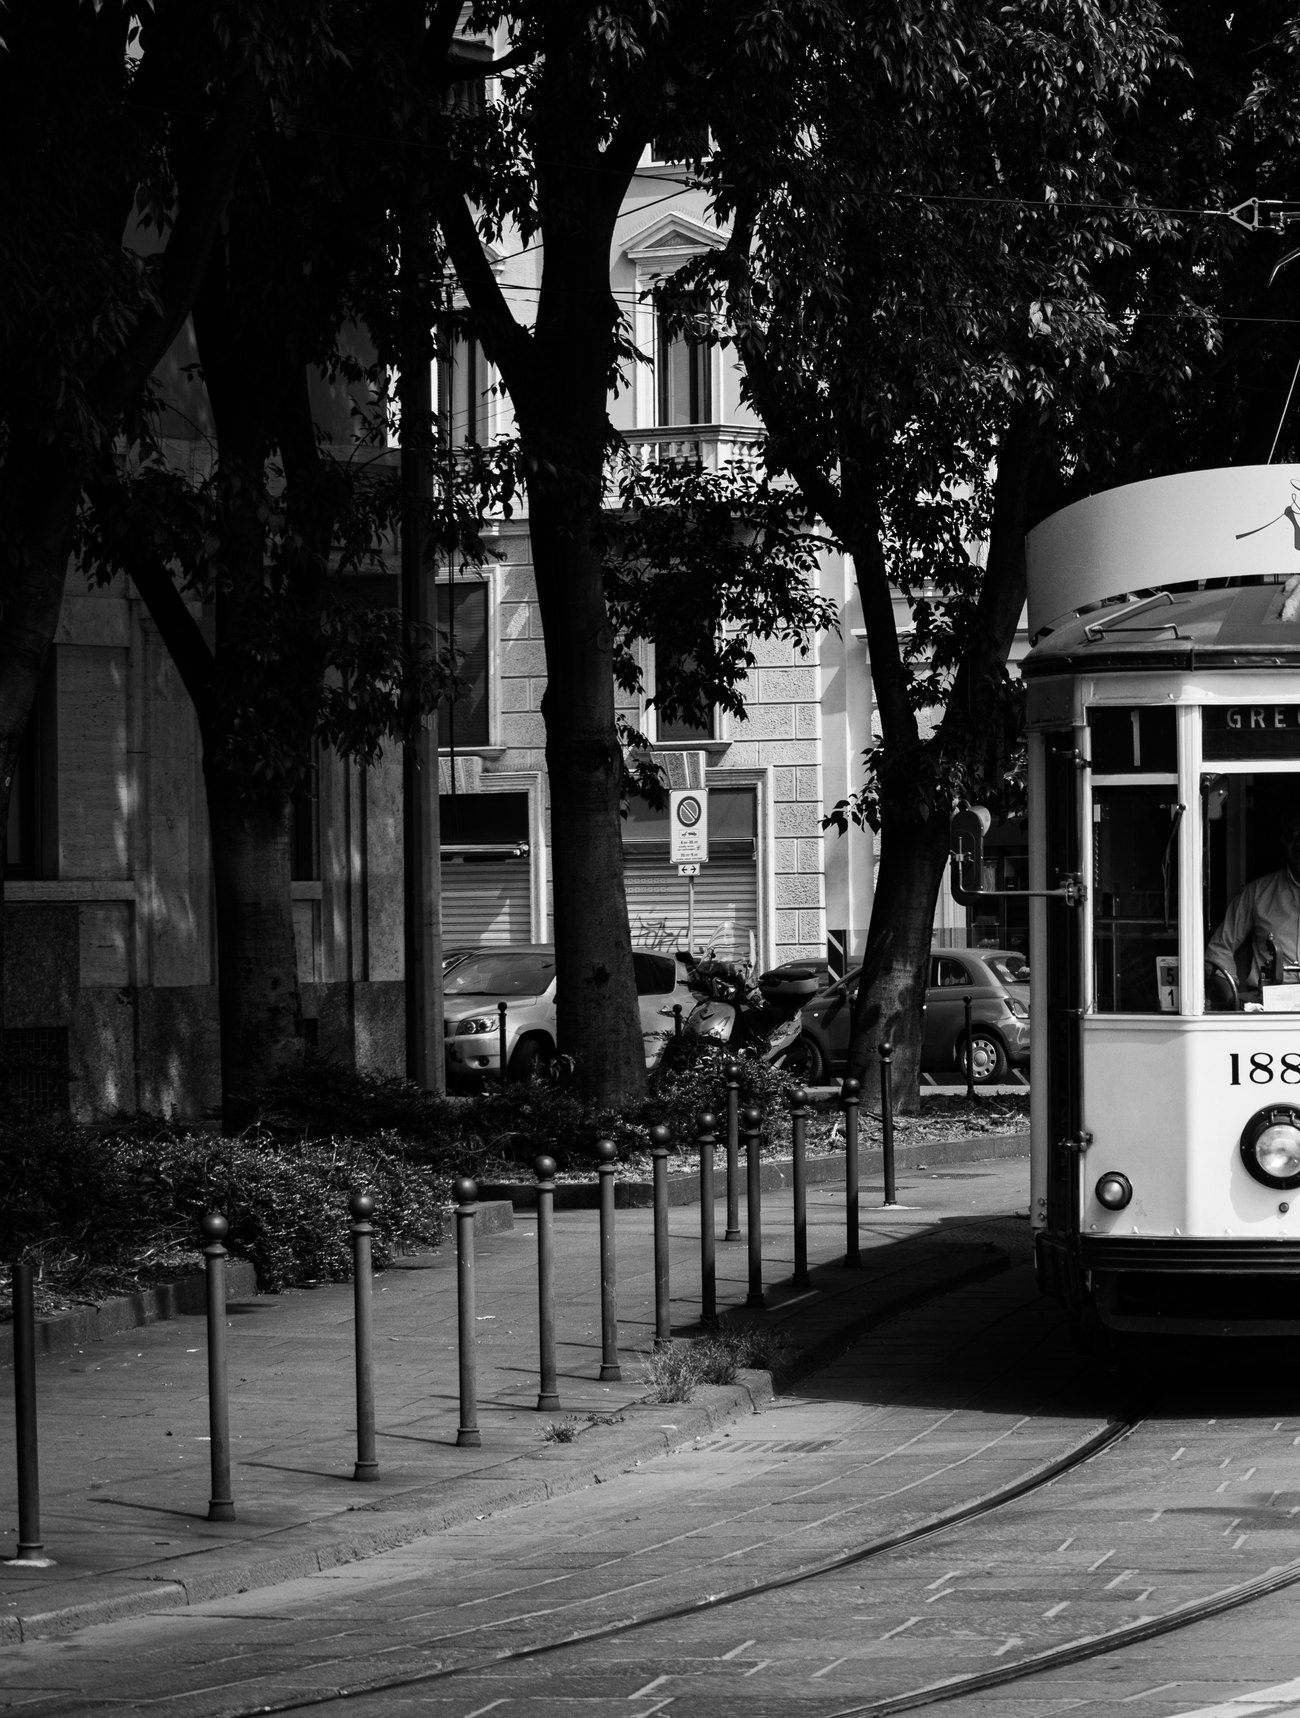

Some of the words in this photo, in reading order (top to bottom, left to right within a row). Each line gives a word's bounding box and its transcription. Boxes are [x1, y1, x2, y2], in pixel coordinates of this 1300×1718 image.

[1130, 709, 1141, 767] 1
[1166, 967, 1175, 985] 5
[1167, 988, 1175, 1006] 1
